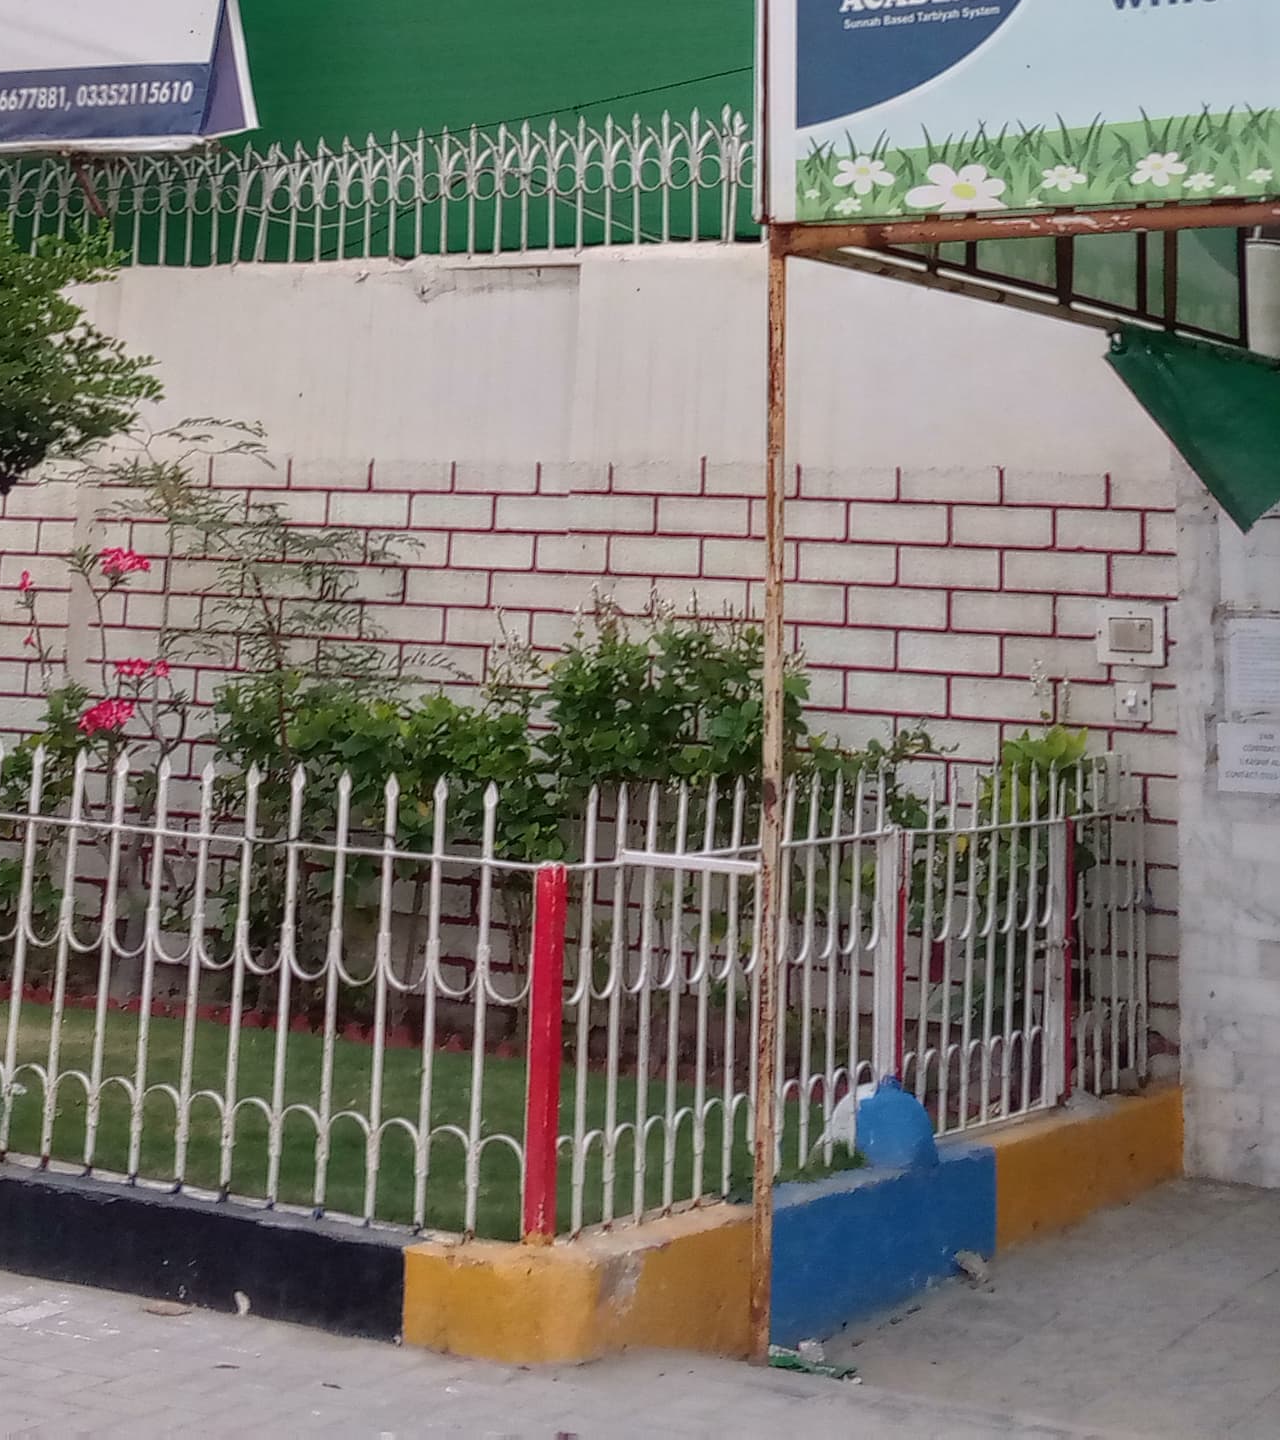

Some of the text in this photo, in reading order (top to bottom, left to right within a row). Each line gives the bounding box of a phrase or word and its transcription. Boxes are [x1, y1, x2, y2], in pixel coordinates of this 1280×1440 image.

[843, 5, 1001, 30] Sunnah Based Tarbiyah System
[75, 80, 194, 108] 03352115610
